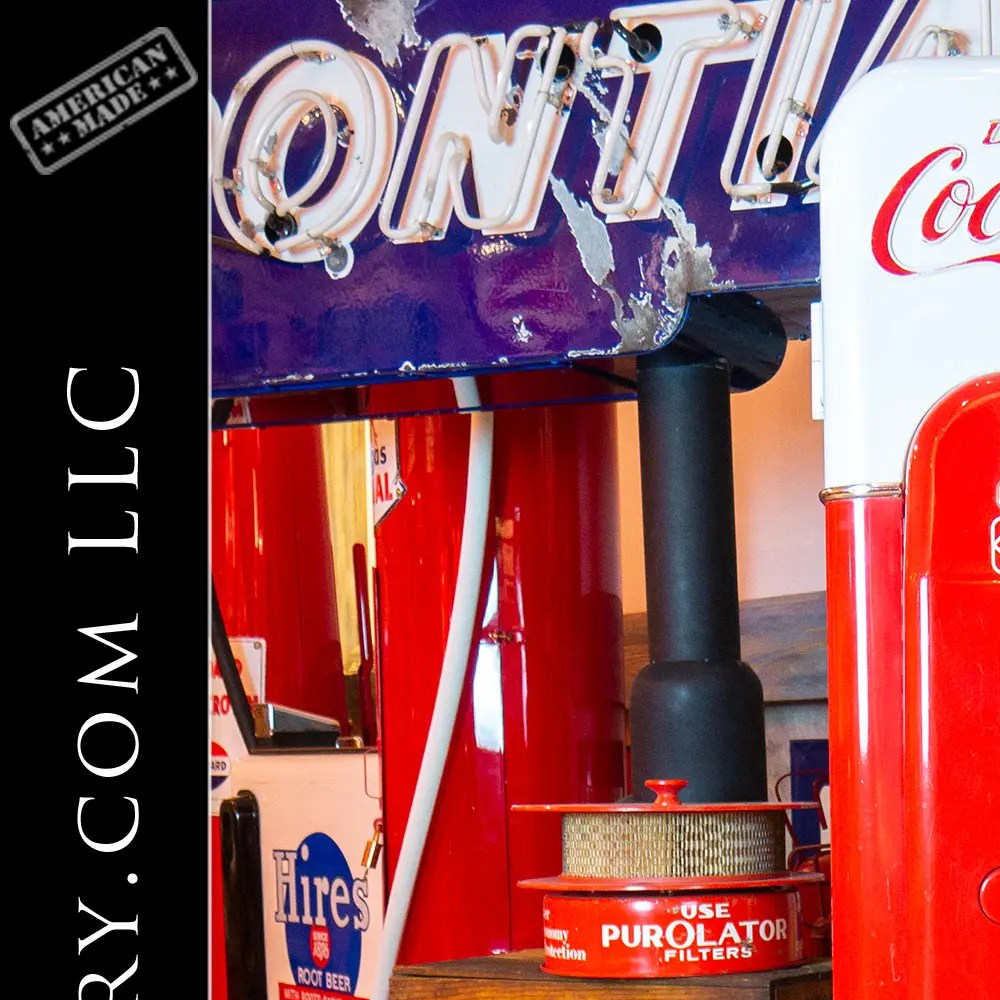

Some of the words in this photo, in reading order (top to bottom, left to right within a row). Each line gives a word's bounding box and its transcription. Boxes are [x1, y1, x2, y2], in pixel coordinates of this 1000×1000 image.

[273, 844, 370, 932] Hires
[681, 903, 730, 919] USE
[601, 918, 787, 948] PUROLATOR
[664, 947, 753, 962] FILTERS
[297, 966, 323, 986] ROOT
[326, 971, 351, 993] BEER
